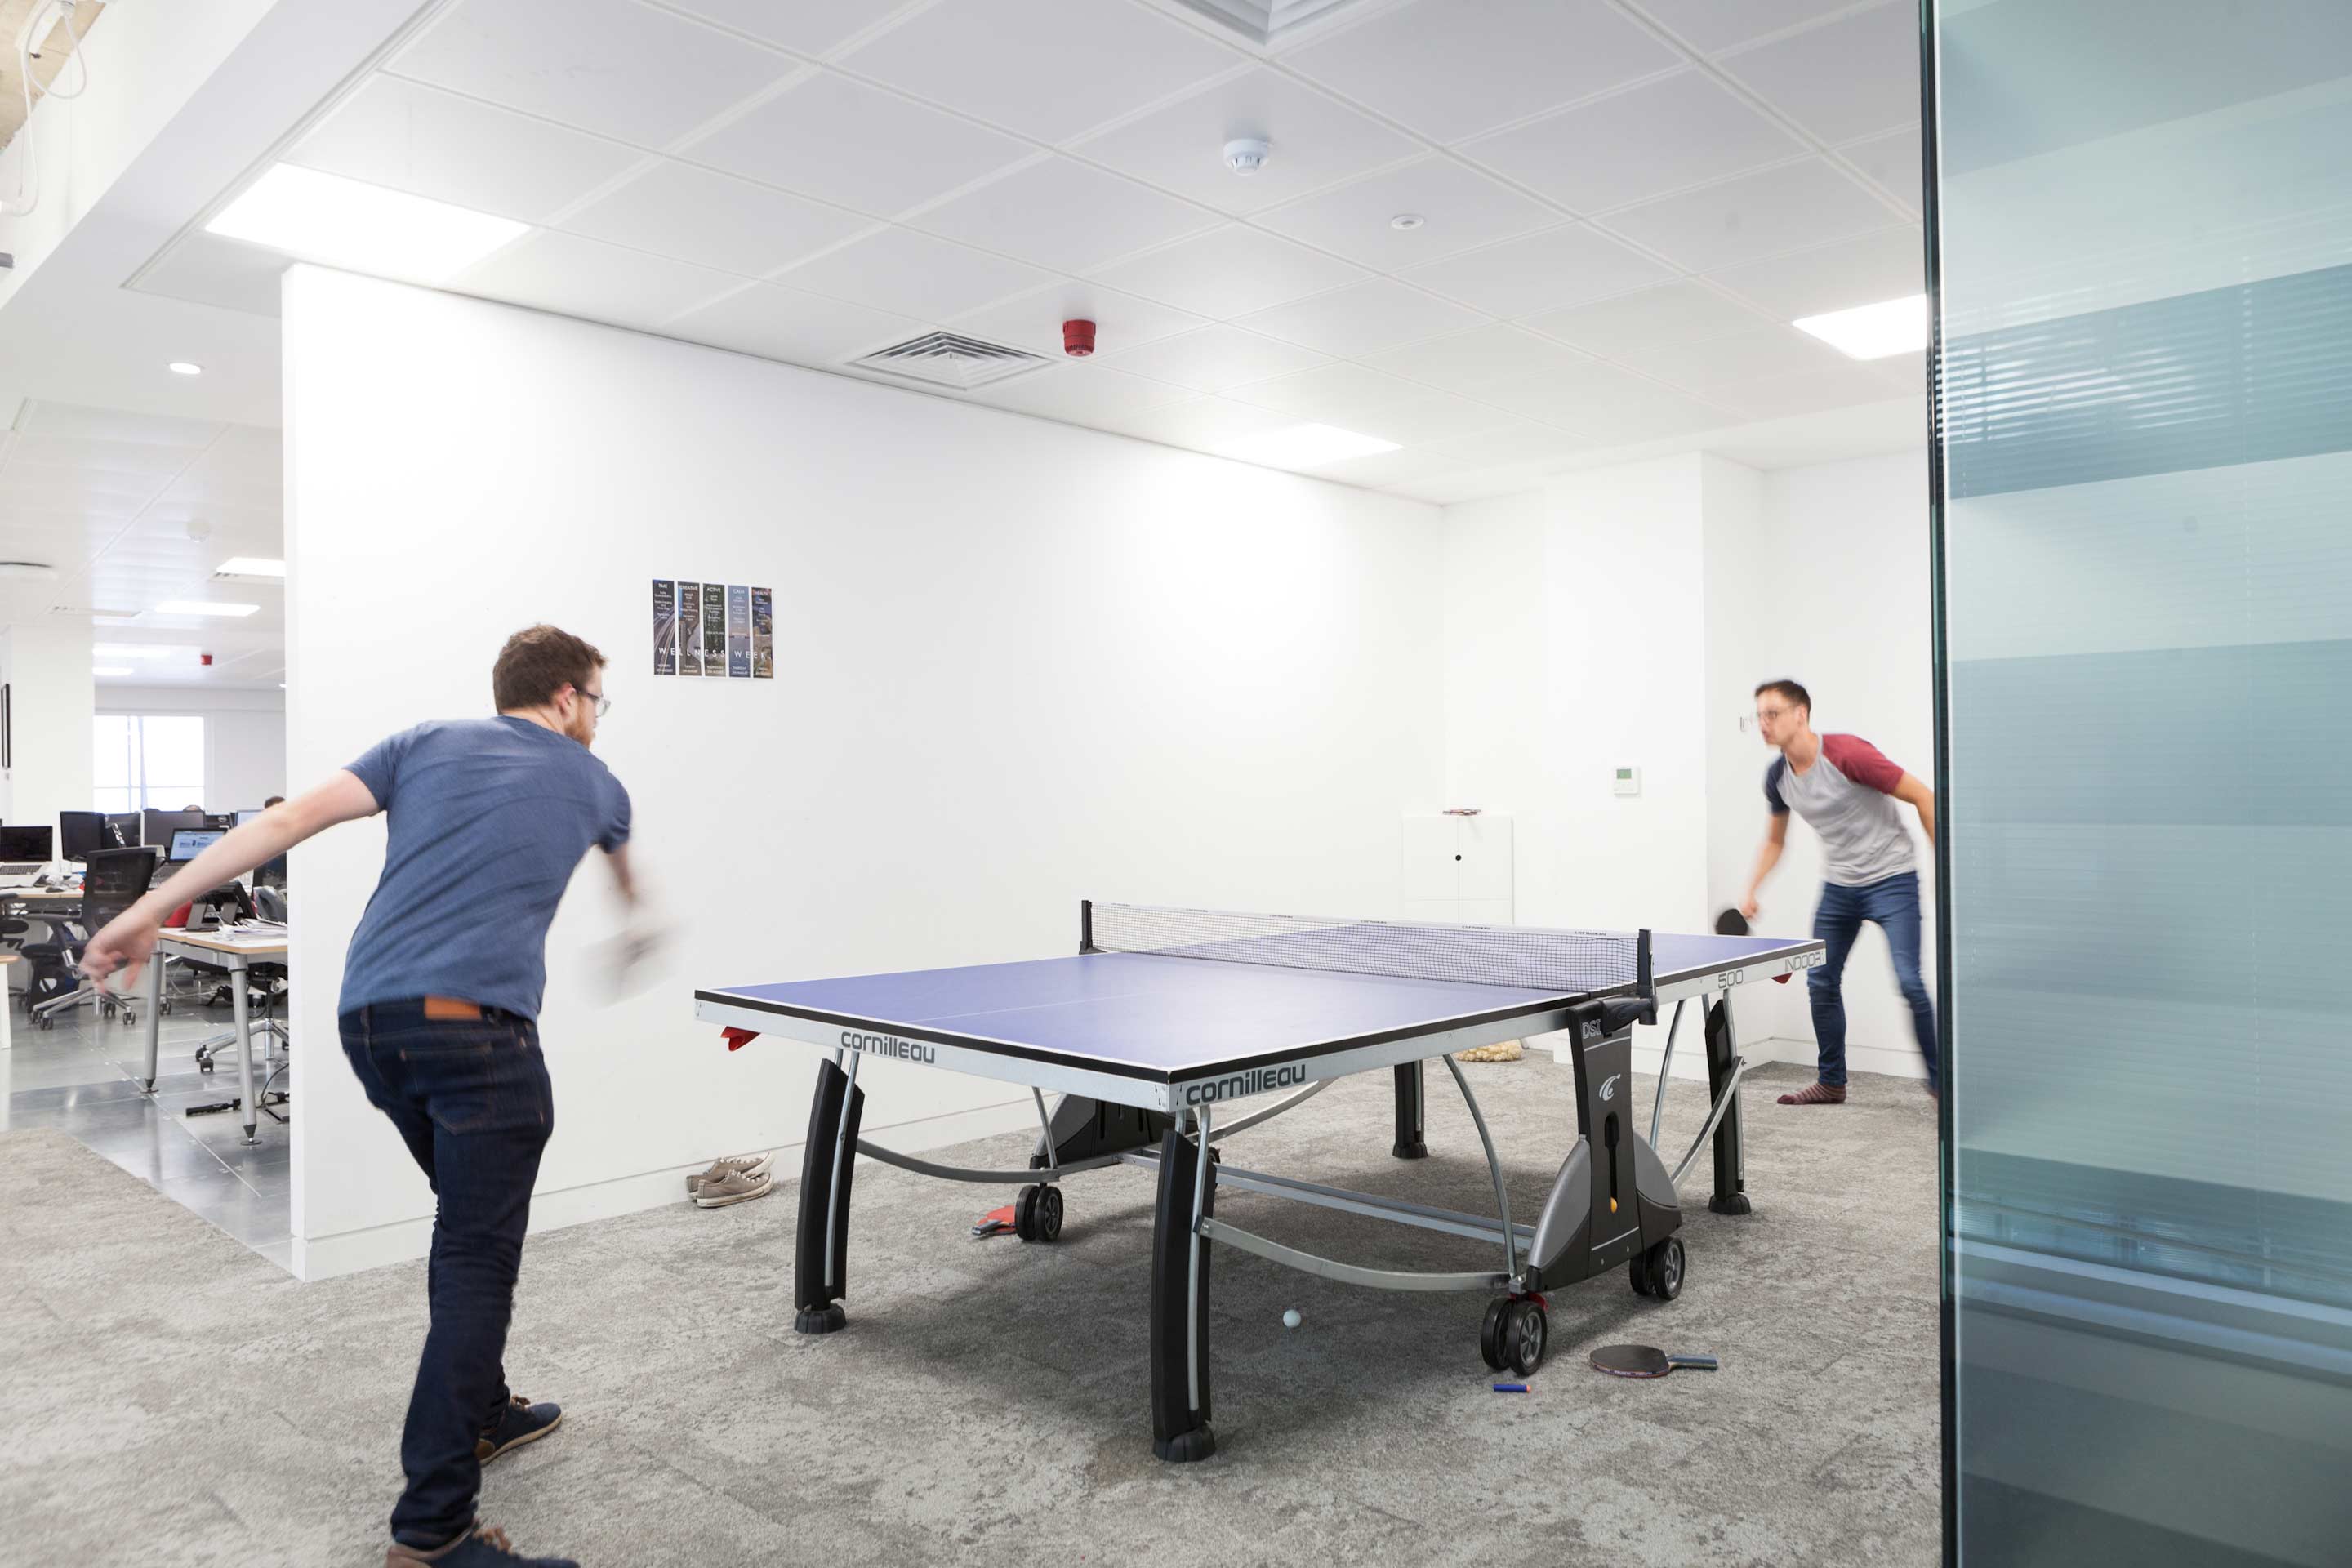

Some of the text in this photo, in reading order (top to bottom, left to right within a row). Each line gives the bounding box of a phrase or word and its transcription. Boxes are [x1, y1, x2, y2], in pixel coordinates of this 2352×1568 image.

[658, 647, 766, 660] WELLNESS WEEK
[1785, 951, 1820, 972] INDOOR
[1718, 969, 1744, 988] 500
[840, 1031, 935, 1064] cornilleau
[1186, 1064, 1306, 1105] cornilleau
